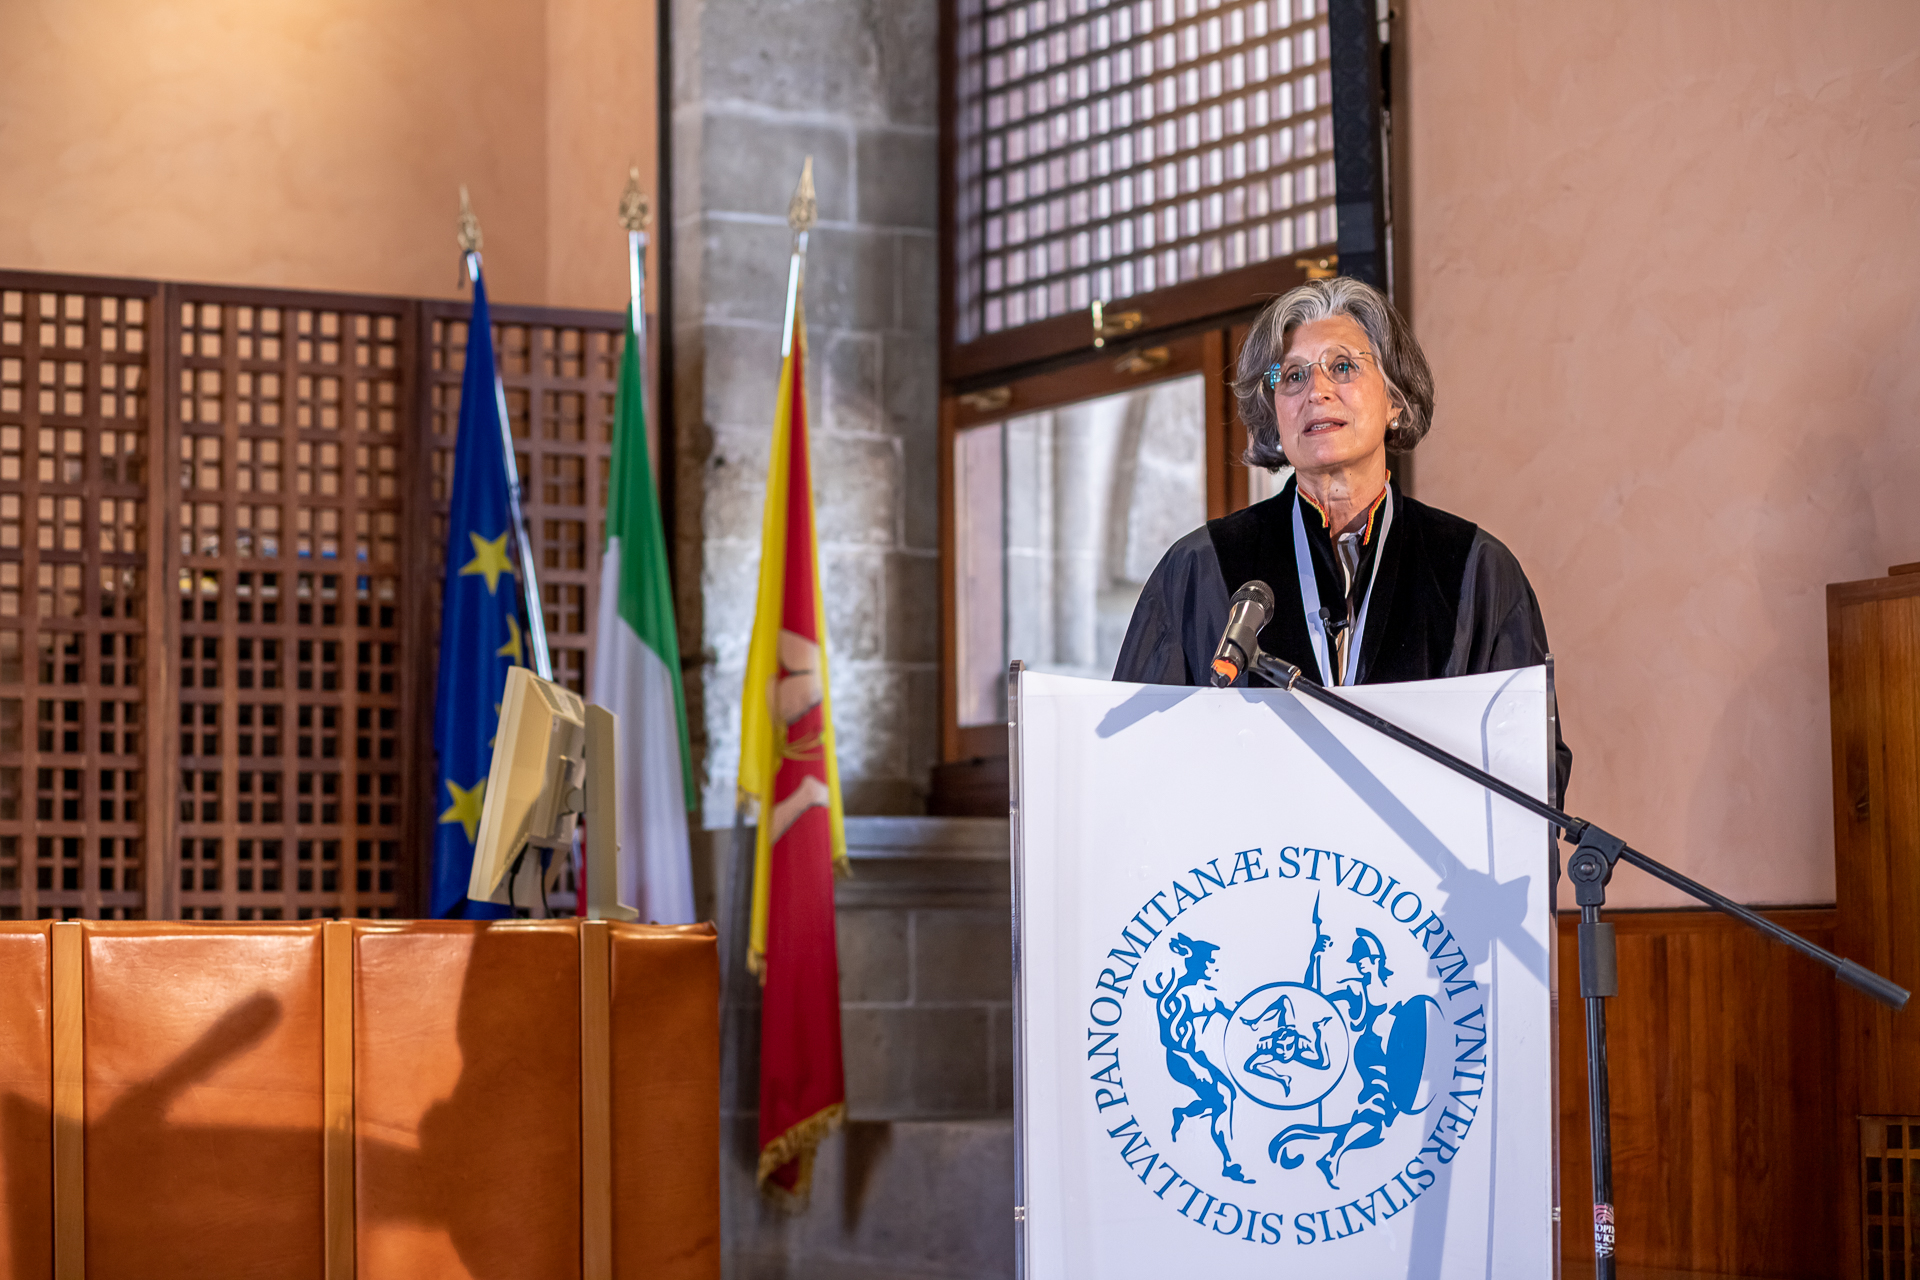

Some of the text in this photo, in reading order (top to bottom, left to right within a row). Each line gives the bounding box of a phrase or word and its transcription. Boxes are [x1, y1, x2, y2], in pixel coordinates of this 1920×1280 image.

[1087, 846, 1488, 1246] PANORMITANÆ STVDIORVM VNIVERSITATIS SIGILLVM
